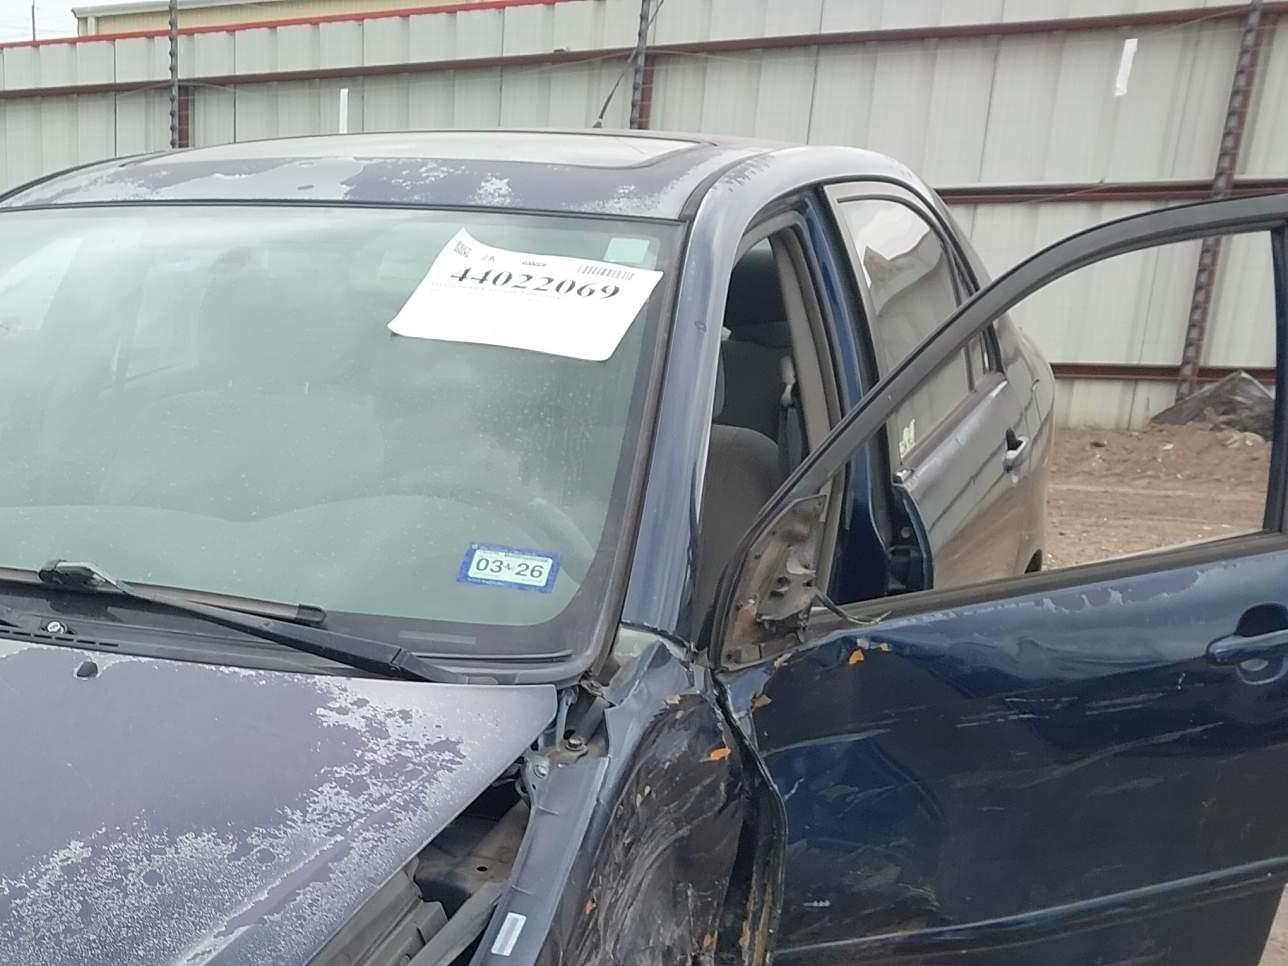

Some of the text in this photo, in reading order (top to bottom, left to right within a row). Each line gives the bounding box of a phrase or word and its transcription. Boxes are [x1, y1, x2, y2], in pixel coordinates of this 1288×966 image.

[450, 266, 620, 300] 44022069
[475, 557, 545, 579] 03 26
